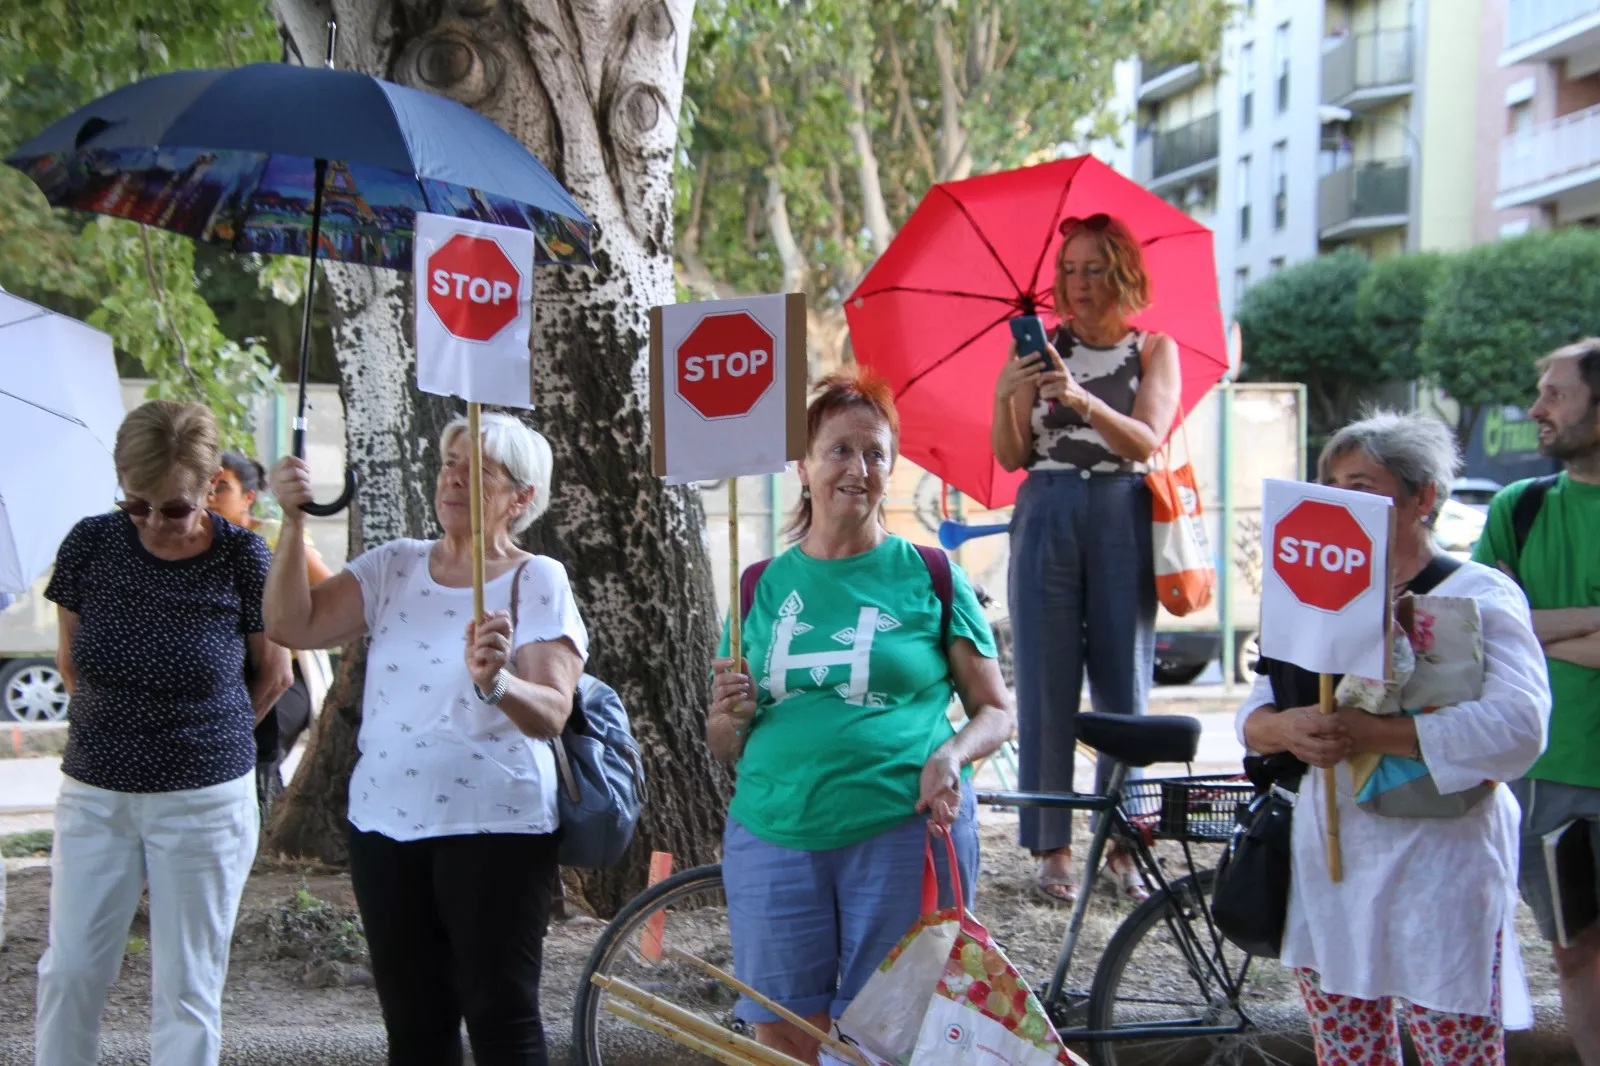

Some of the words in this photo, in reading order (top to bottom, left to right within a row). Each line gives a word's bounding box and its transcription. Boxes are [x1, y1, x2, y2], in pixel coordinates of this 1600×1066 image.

[432, 269, 512, 305] STOP
[684, 349, 768, 382] STOP
[1278, 536, 1366, 574] STOP
